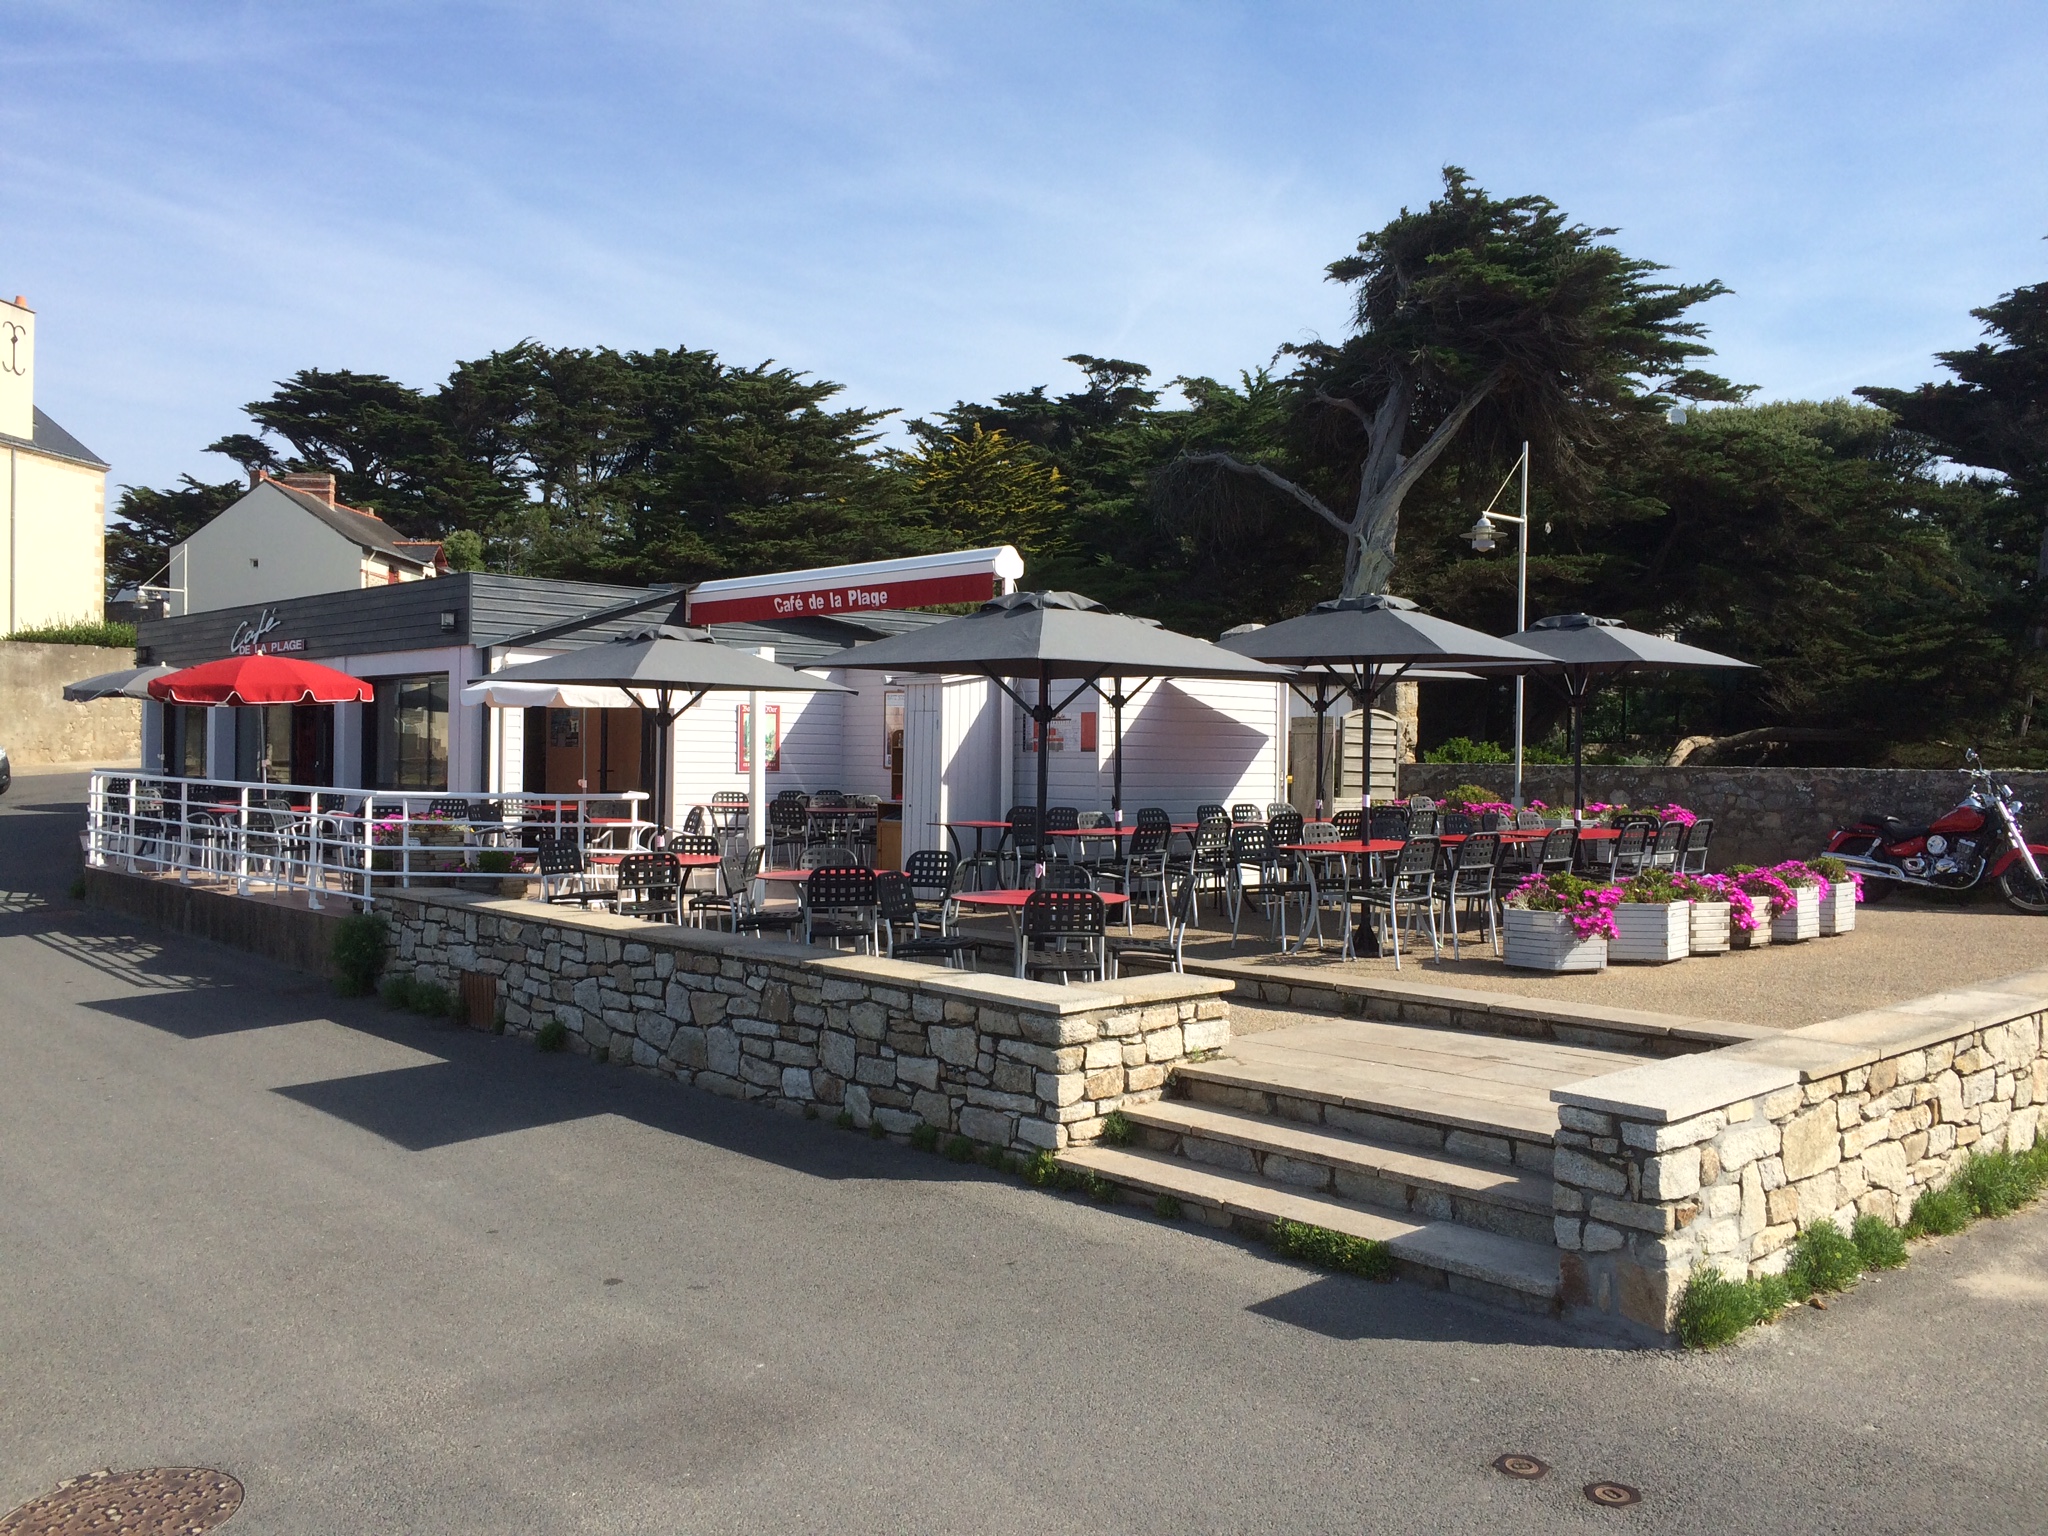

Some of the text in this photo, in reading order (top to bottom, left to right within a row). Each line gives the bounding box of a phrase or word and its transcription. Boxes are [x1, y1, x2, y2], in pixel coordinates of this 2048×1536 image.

[774, 589, 888, 613] Café de la Plage
[230, 607, 281, 652] Café
[239, 639, 302, 655] DE LA PLAGE
